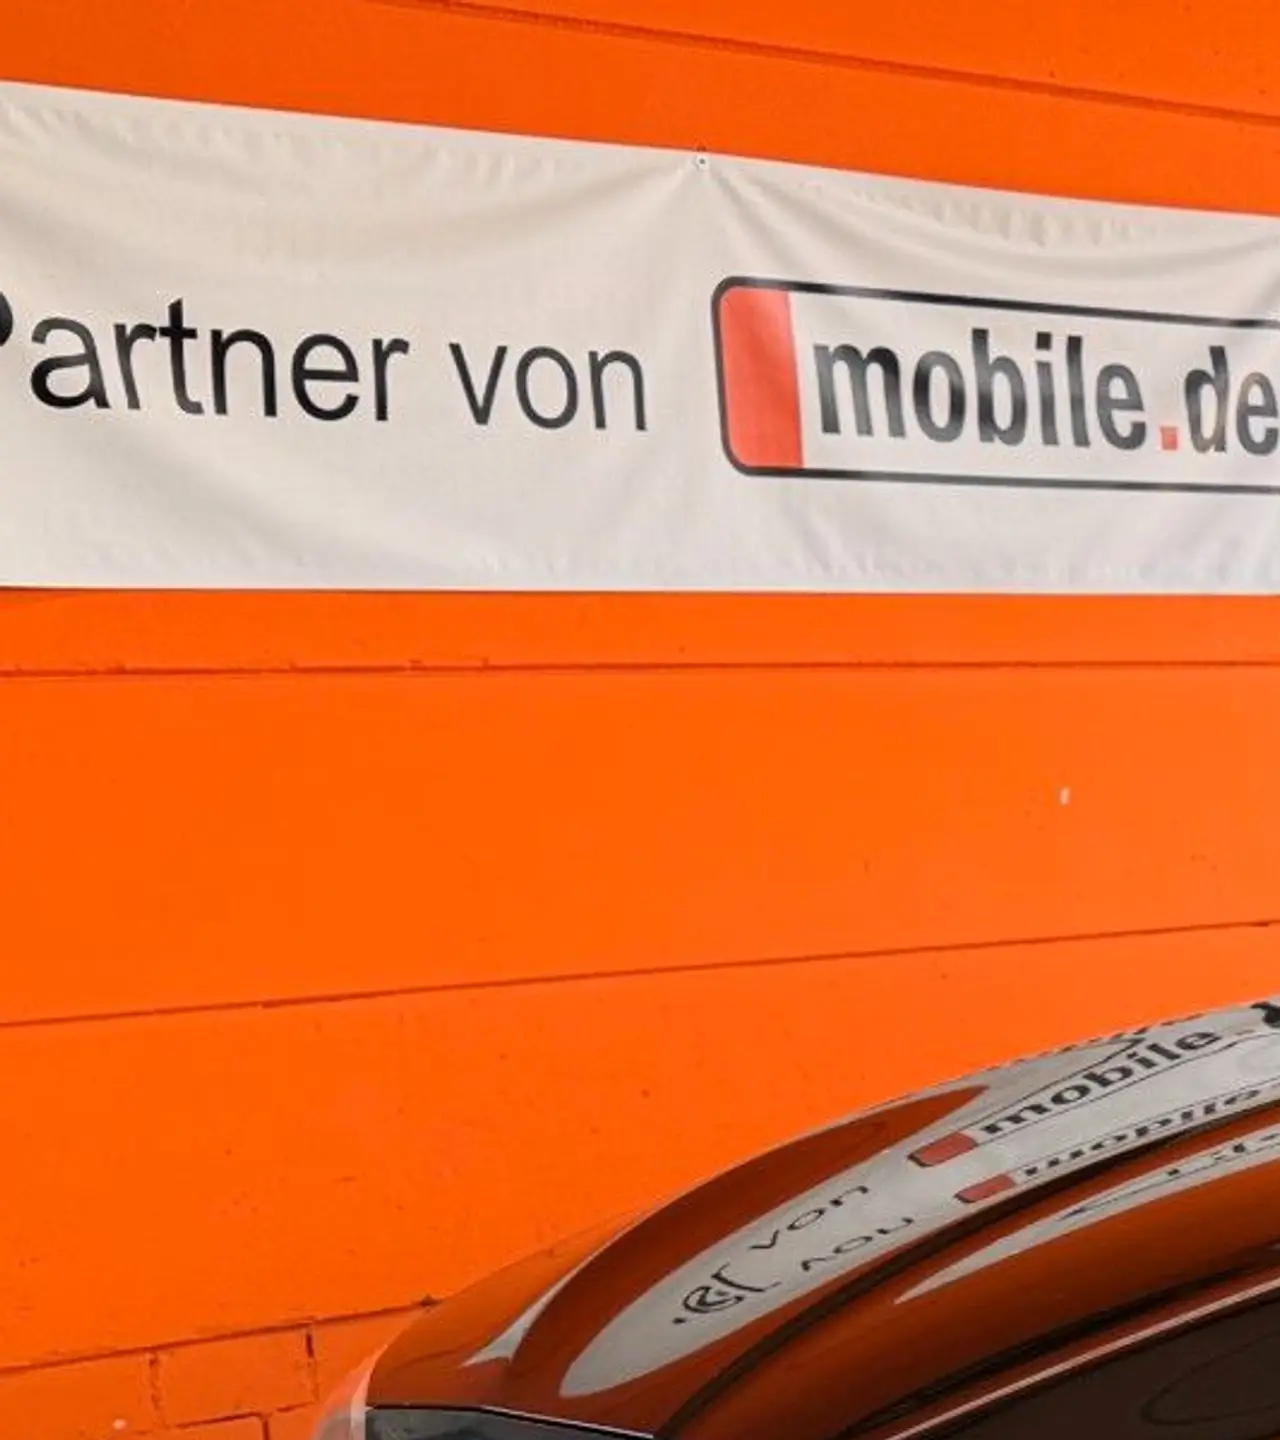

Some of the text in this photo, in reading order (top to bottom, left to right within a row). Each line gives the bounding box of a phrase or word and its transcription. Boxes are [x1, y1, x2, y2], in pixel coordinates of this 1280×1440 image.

[0, 290, 1280, 456] artner von mobile.de
